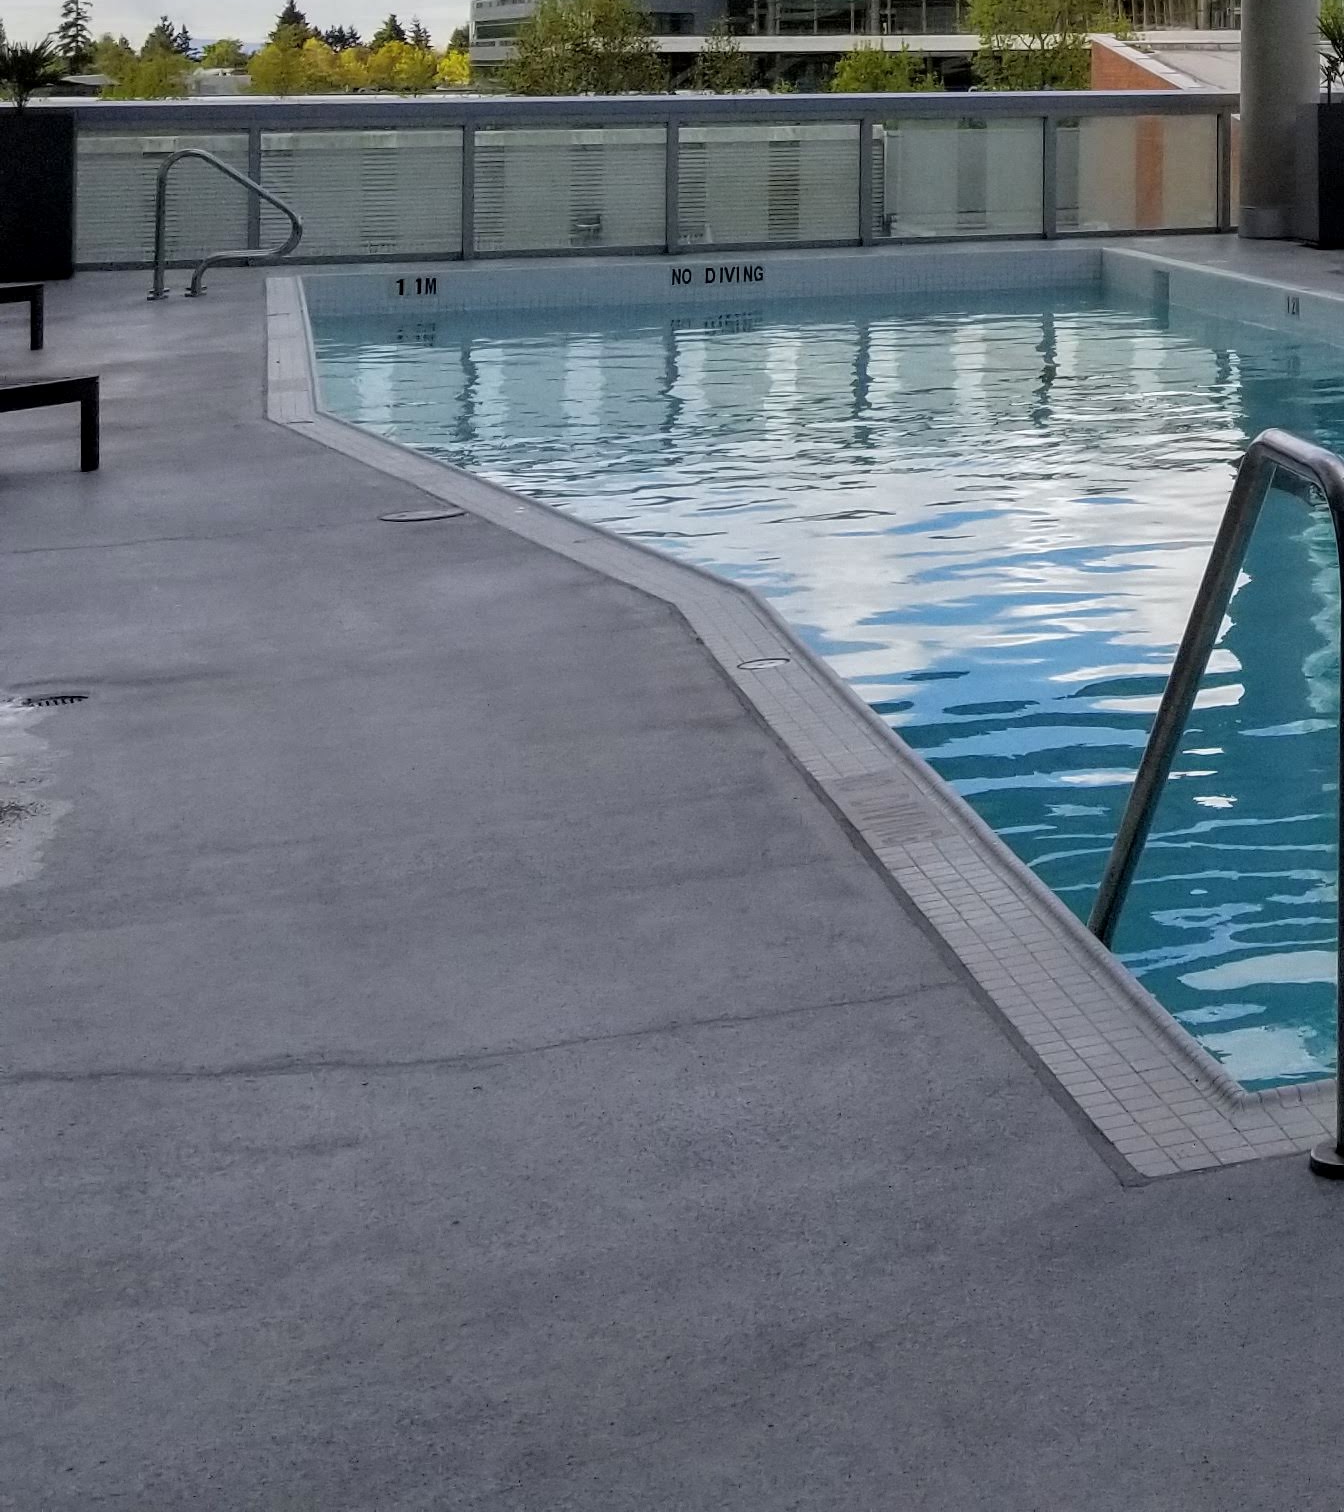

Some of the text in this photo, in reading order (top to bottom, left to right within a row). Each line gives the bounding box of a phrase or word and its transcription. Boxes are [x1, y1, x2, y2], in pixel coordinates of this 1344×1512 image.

[672, 266, 764, 285] NO DIVING
[396, 278, 437, 296] 11M
